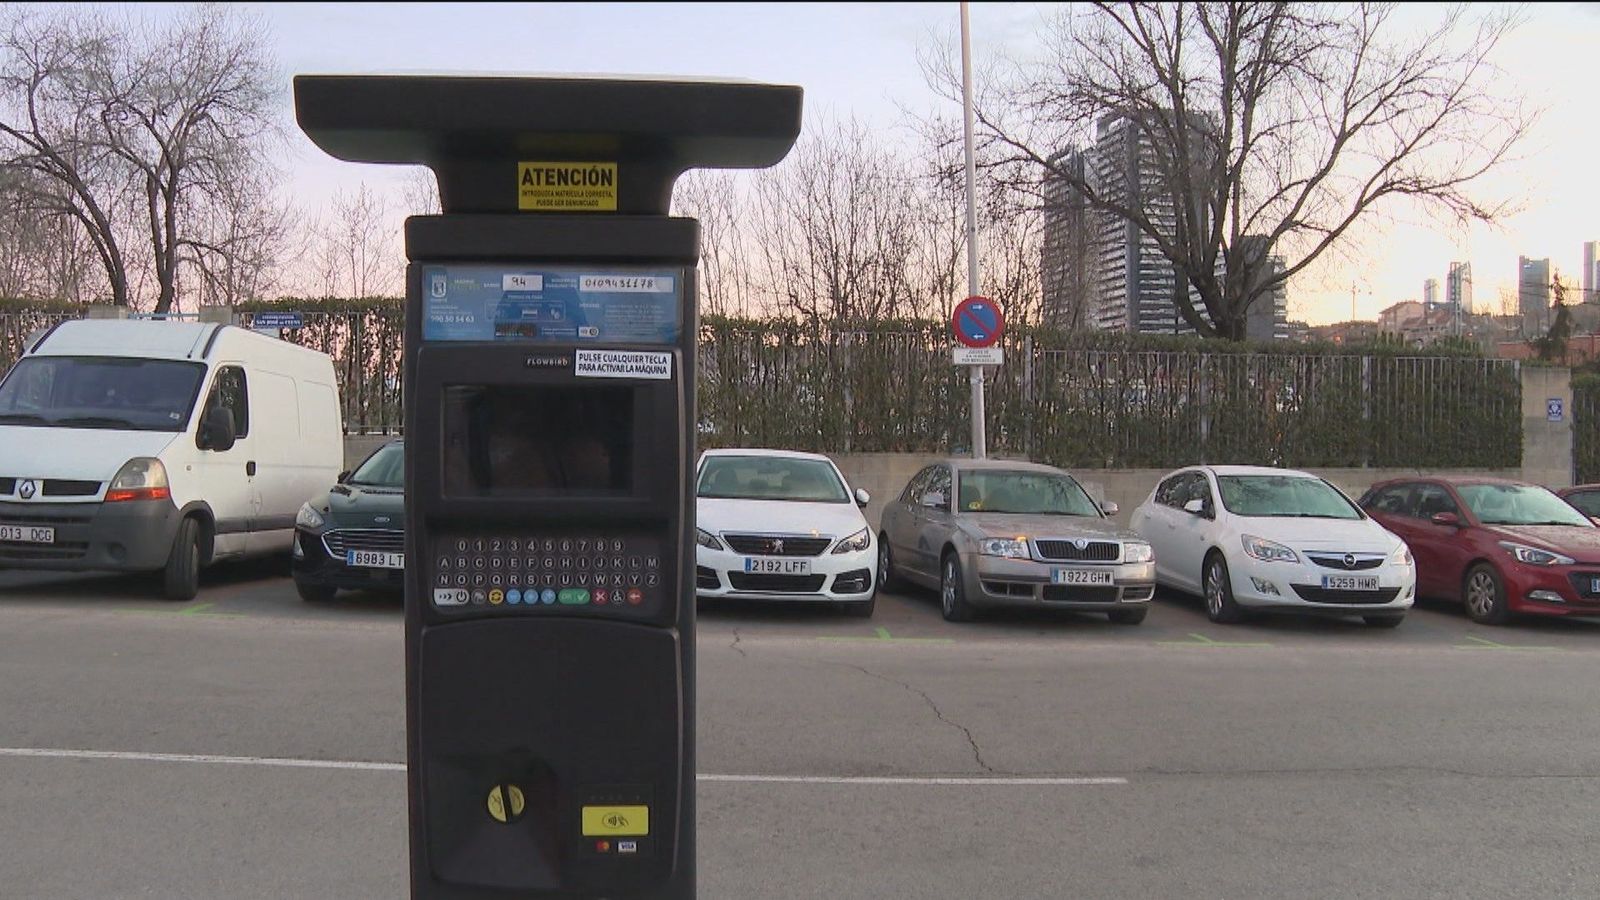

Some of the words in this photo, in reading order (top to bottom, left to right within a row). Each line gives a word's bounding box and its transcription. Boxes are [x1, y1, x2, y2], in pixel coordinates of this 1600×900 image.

[521, 165, 613, 186] ATENCIÓN
[512, 276, 526, 287] 94
[578, 354, 601, 362] PULSE
[602, 354, 644, 364] CUALQUIER
[645, 356, 668, 364] TECLA
[597, 364, 625, 372] ACTIVAR
[626, 364, 634, 372] LA
[31, 528, 51, 541] DCG
[459, 541, 466, 551] 0
[477, 541, 482, 551] 1
[493, 541, 500, 551] 2
[510, 541, 518, 551] 3
[527, 541, 535, 551] 4
[545, 541, 552, 551] 5
[562, 541, 570, 551] 6
[580, 541, 587, 551] 7
[597, 541, 604, 551] 8
[614, 541, 621, 551] 9
[389, 555, 404, 566] LT
[440, 559, 448, 568] A
[458, 559, 466, 568] B
[475, 559, 483, 568] C
[493, 559, 500, 568] D
[510, 559, 518, 568] E
[528, 559, 534, 568] F
[544, 559, 552, 568] G
[562, 559, 570, 568] H
[581, 559, 585, 568] I
[597, 559, 603, 568] J
[614, 559, 622, 568] K
[632, 559, 638, 568] L
[648, 559, 657, 568] M
[752, 560, 781, 572] 2192
[785, 561, 807, 572] LFF
[440, 575, 448, 584] N
[458, 575, 466, 584] O
[476, 575, 483, 584] P
[492, 575, 501, 584] Q
[510, 575, 518, 584] R
[527, 575, 534, 584] S
[545, 575, 552, 584] T
[562, 575, 570, 584] U
[579, 575, 587, 584] V
[595, 575, 606, 584] W
[613, 575, 621, 584] X
[631, 575, 639, 584] Y
[648, 575, 656, 584] Z
[1062, 572, 1088, 583] 1922
[1090, 572, 1111, 583] GHW
[1330, 577, 1354, 588] 5259
